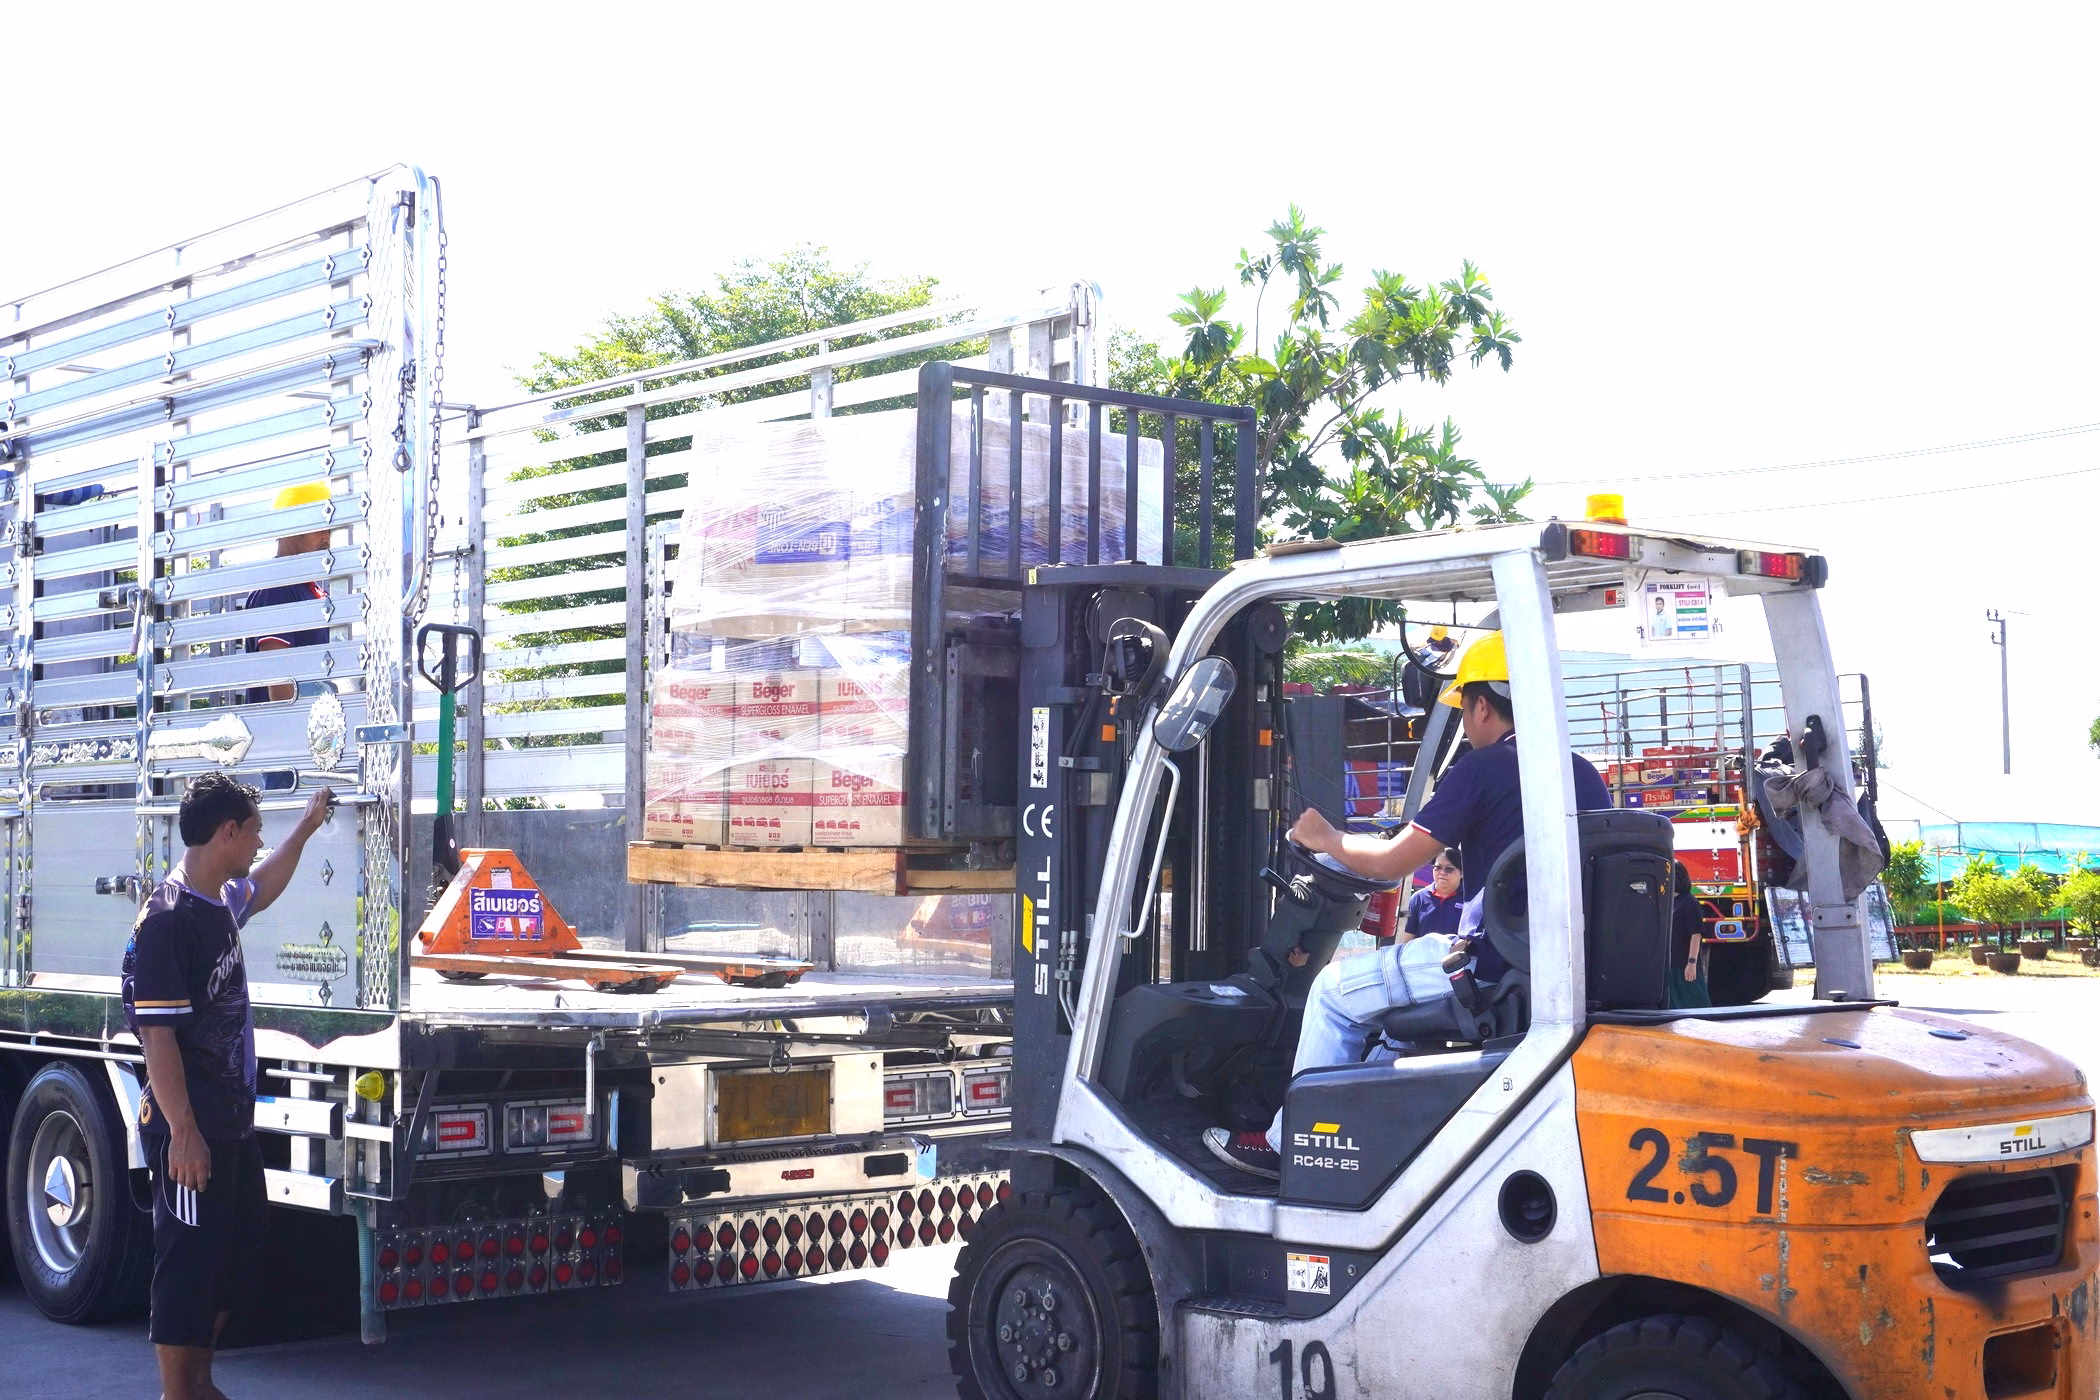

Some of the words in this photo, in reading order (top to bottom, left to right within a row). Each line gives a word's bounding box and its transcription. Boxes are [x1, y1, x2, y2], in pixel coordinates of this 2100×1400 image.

[669, 684, 711, 704] Beger
[753, 682, 795, 702] Beger
[741, 705, 781, 717] SUPERGLOSS
[782, 704, 809, 715] ENAMEL
[746, 768, 789, 788] เบเยอร์
[1647, 773, 1666, 781] Beger
[863, 794, 892, 805] ENAMEL
[474, 890, 540, 913] สีเบเยอร์
[1034, 855, 1051, 995] STILL
[1294, 1133, 1360, 1151] STILL
[2000, 1137, 2046, 1154] STILL
[1294, 1155, 1360, 1171] RC42-25
[1626, 1128, 1797, 1214] 2.5T
